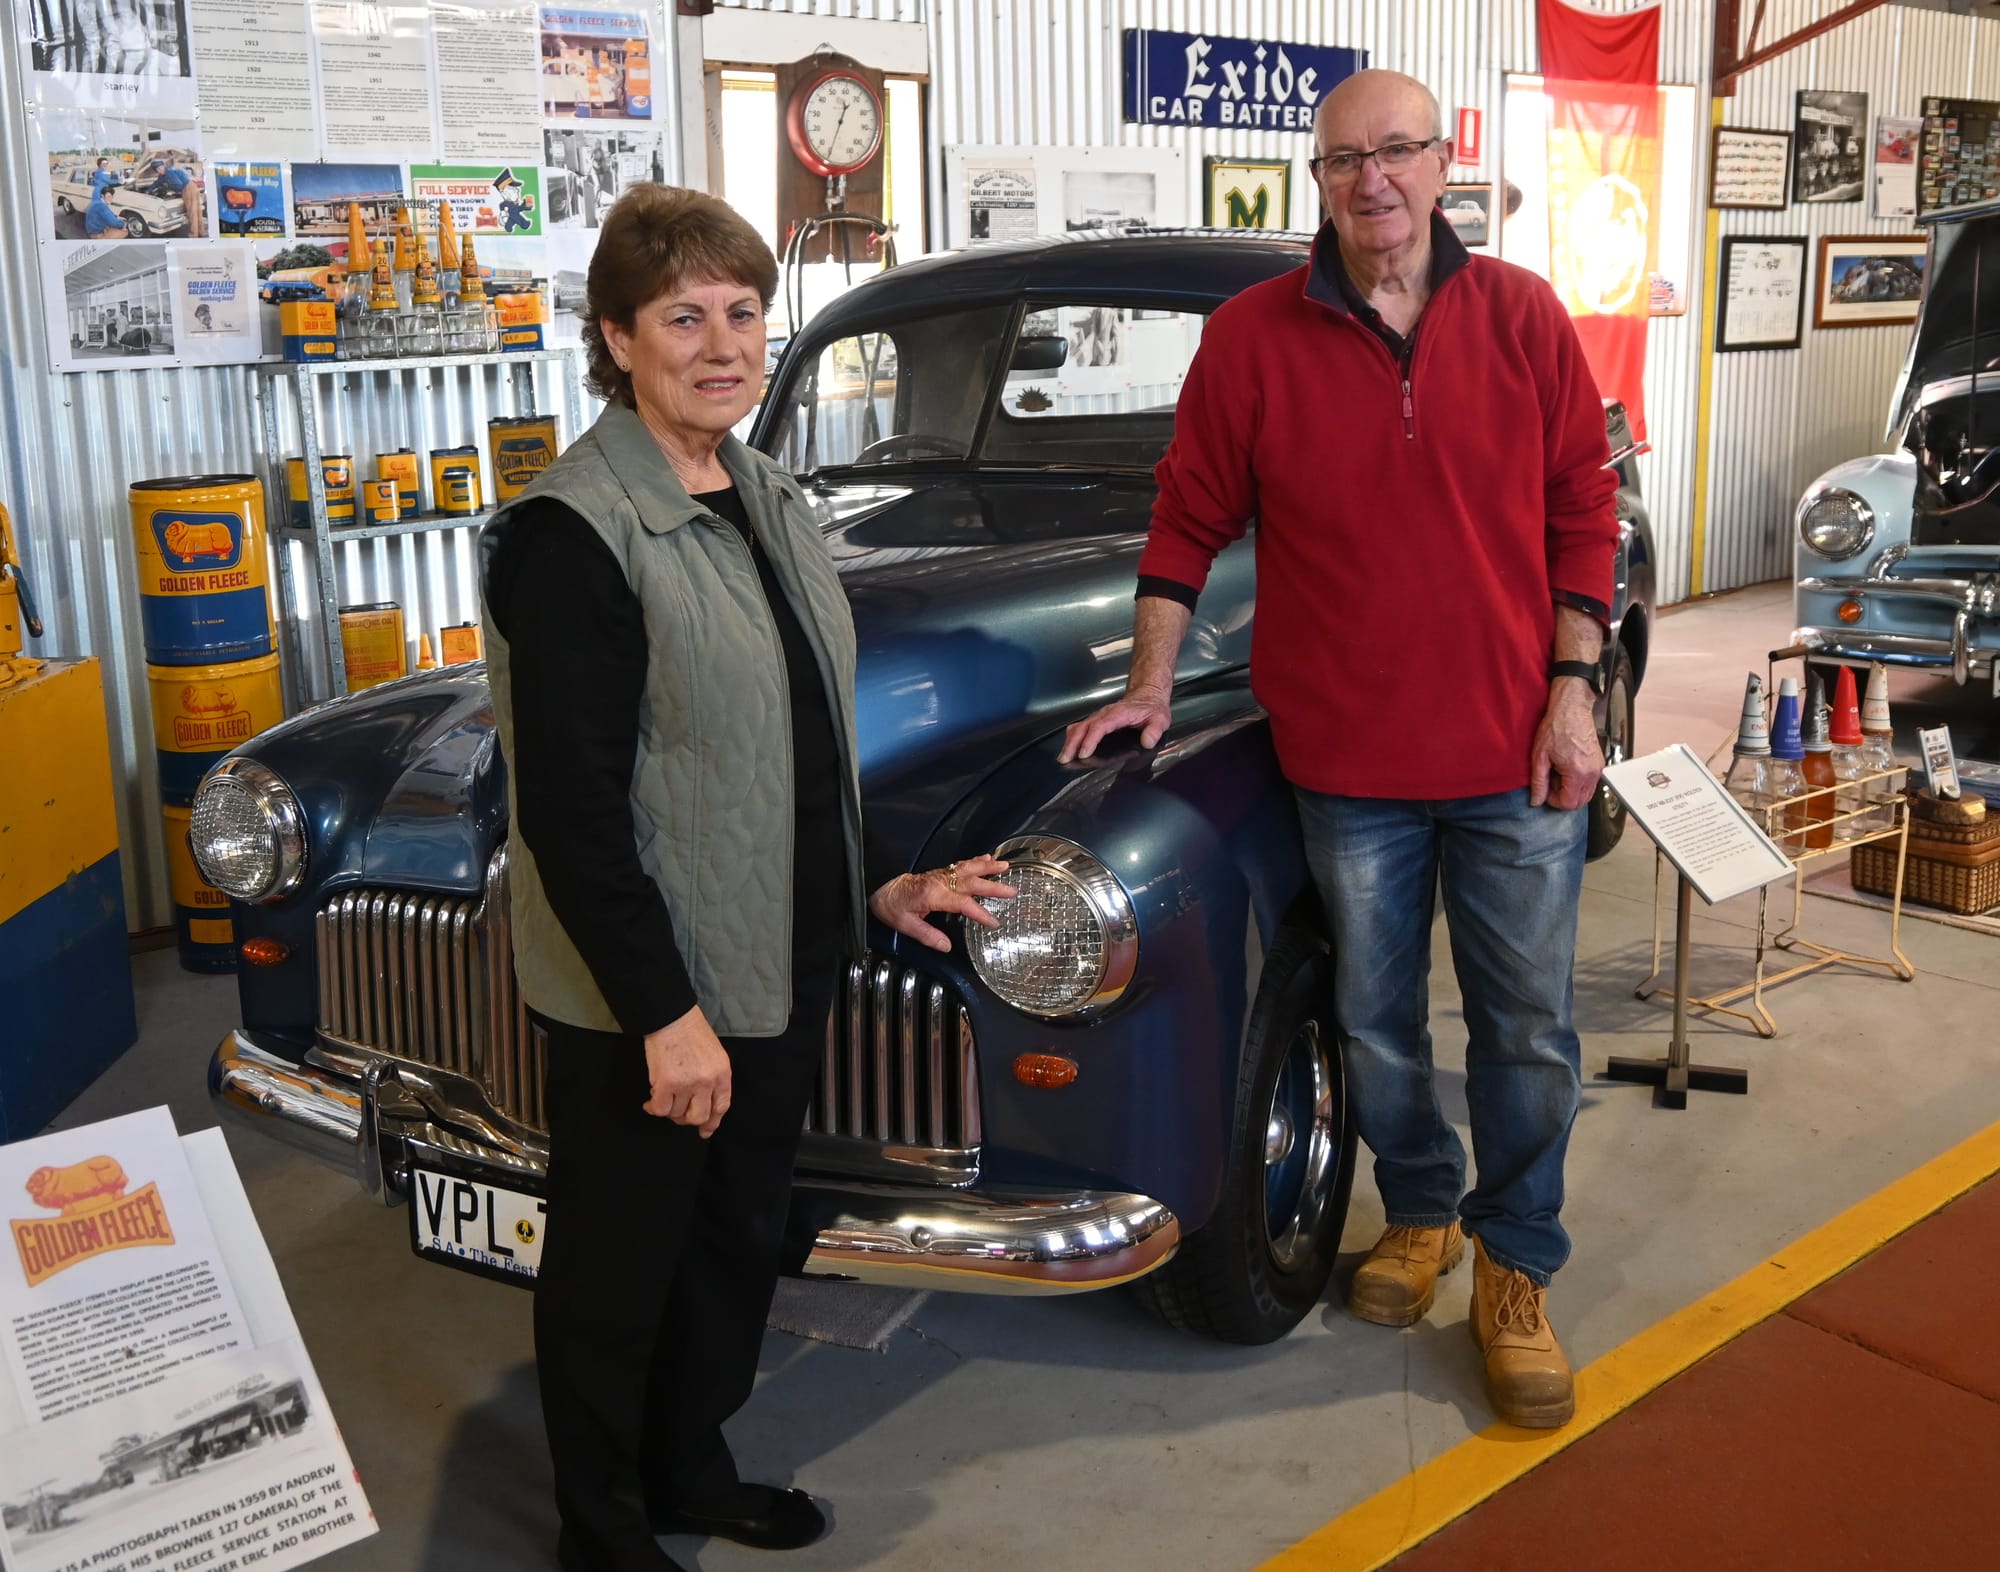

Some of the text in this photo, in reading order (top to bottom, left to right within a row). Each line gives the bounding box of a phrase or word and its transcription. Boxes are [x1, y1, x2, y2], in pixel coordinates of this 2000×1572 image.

[104, 82, 139, 94] Stanley
[1183, 37, 1320, 105] Exide
[1151, 96, 1318, 128] CAR BATTER
[419, 185, 490, 195] FULL SERVICE
[187, 280, 237, 290] GOLDEN FLEECE
[500, 450, 548, 470] GOLDEN FLEECE
[159, 570, 249, 593] GOLDEN FLEECE
[177, 717, 248, 743] GOLDEN FLEECE
[418, 1172, 514, 1258] VPL
[17, 1189, 170, 1276] GOLDEN FLEECE
[469, 1247, 498, 1267] The
[12, 1316, 25, 1324] THE
[84, 1292, 105, 1302] ITEMS
[119, 1280, 145, 1291] DISPLAY
[146, 1274, 163, 1283] HERE
[164, 1263, 199, 1277] BELONGED
[85, 1299, 114, 1311] STARTED
[115, 1287, 153, 1302] COLLECTING
[175, 1275, 191, 1283] LATE
[90, 1317, 116, 1329] OWNED
[120, 1311, 135, 1319] AND
[138, 1299, 173, 1313] OPERATED
[191, 1285, 218, 1296] GOLDEN
[102, 1303, 130, 1315] GOLDEN
[130, 1296, 153, 1307] FLEECE
[154, 1283, 194, 1299] ORIGINATED
[195, 1277, 215, 1286] FROM
[163, 1305, 183, 1315] AFTER
[183, 1296, 212, 1309] MOVING
[168, 1324, 189, 1335] SMALL
[191, 1315, 217, 1328] SAMPLE
[209, 1320, 232, 1331] WHICH
[65, 1346, 85, 1356] FROM
[86, 1335, 119, 1349] ENGLAND
[135, 1369, 150, 1379] FOR
[181, 1354, 194, 1363] THE
[194, 1347, 215, 1358] ITEMS
[226, 1339, 238, 1348] THE
[81, 1558, 91, 1569] A
[92, 1523, 180, 1565] PHOTOGRAPH
[182, 1507, 222, 1530] TAKEN
[223, 1502, 237, 1515] IN
[239, 1490, 267, 1508] 1959
[268, 1484, 283, 1499] BY
[286, 1463, 336, 1490] ANDREW
[130, 1553, 152, 1570] HIS
[155, 1528, 215, 1560] BROWNIE
[218, 1519, 240, 1536] 127
[243, 1496, 298, 1527] CAMERA)
[301, 1489, 317, 1503] OF
[320, 1479, 343, 1496] THE
[173, 1549, 216, 1572] FLEECE
[222, 1527, 271, 1554] SERVICE
[277, 1504, 327, 1532] STATION
[334, 1495, 349, 1511] AT
[241, 1547, 270, 1566] ERIC
[272, 1535, 299, 1555] AND
[302, 1512, 357, 1542] BROTHER
